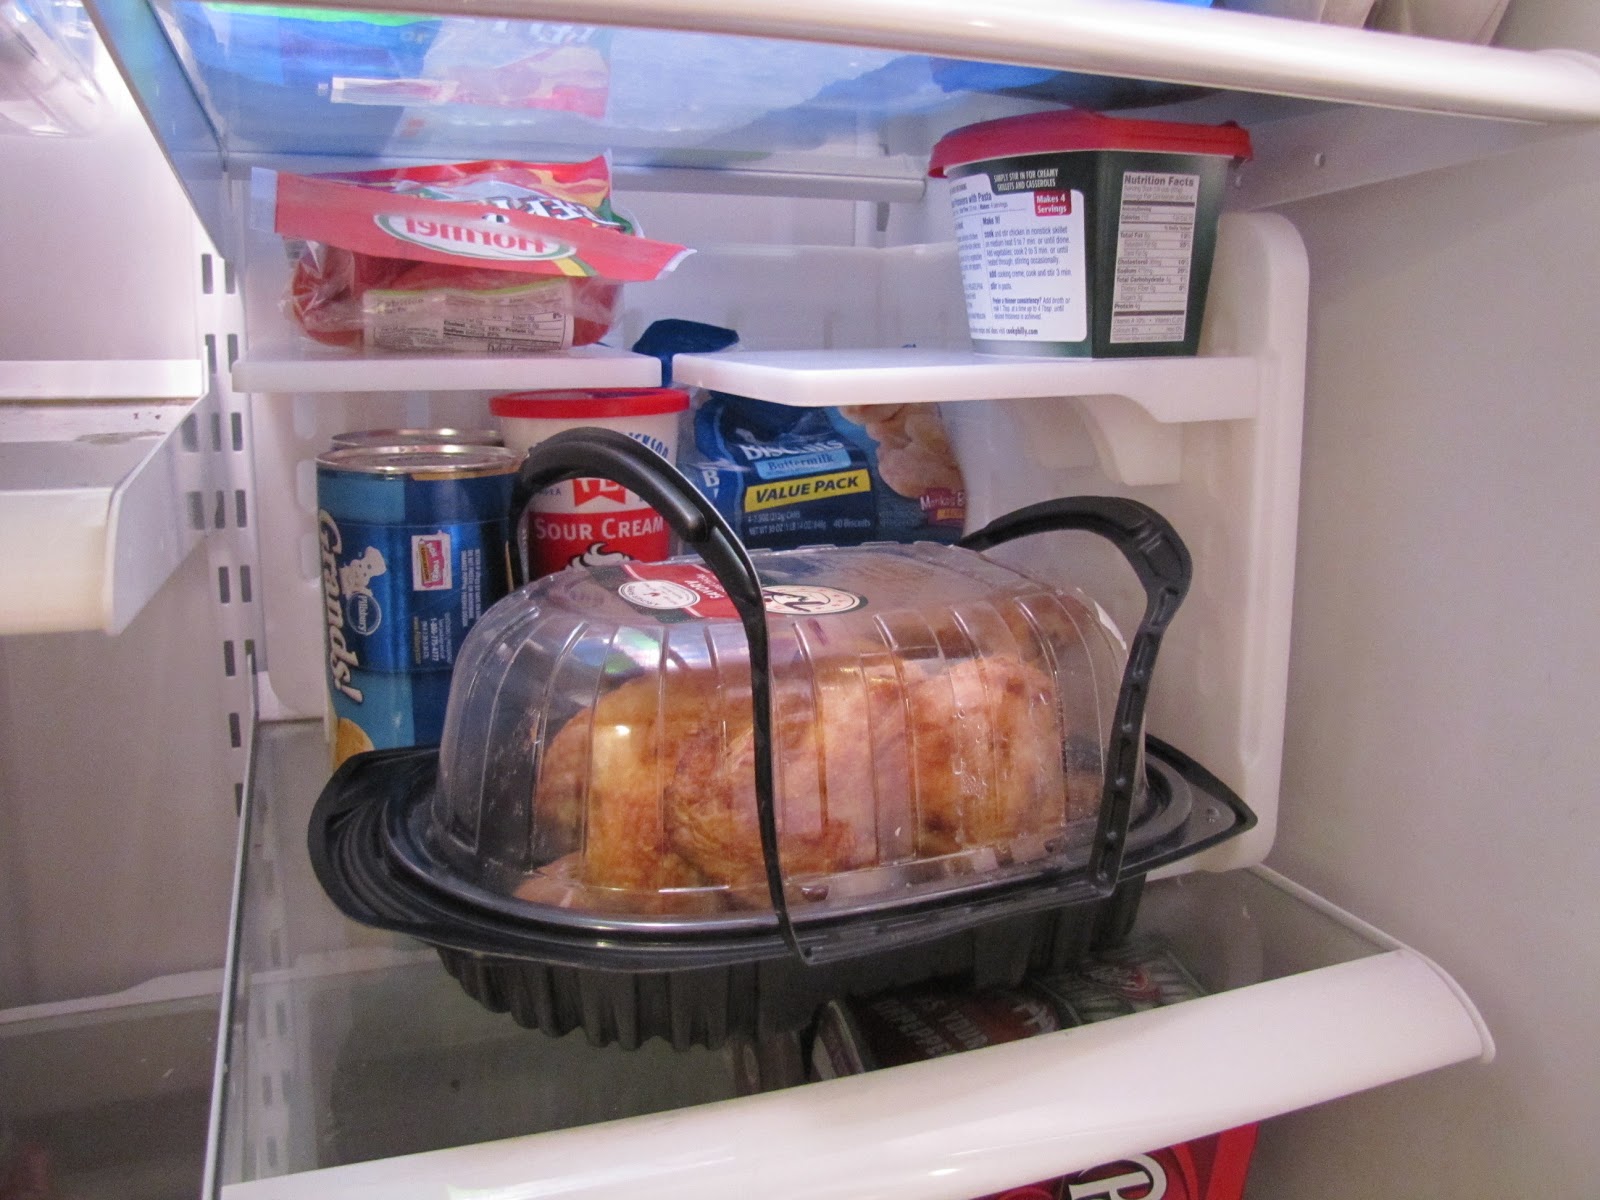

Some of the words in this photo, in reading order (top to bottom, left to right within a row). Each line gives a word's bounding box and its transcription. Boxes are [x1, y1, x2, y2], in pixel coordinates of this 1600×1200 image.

[1124, 175, 1166, 184] Nutrition
[1168, 176, 1194, 186] Facts
[1037, 195, 1058, 204] Makes
[1060, 194, 1066, 202] 4
[1037, 204, 1067, 214] Servings
[1031, 228, 1051, 236] nonstick
[1052, 226, 1068, 234] skillet
[1056, 246, 1068, 254] until
[768, 454, 834, 470] Buttermilk
[756, 483, 811, 504] VALUE
[814, 476, 859, 494] PACK
[534, 518, 593, 540] SOUR
[602, 516, 664, 540] CREAM
[319, 508, 364, 705] Grands!
[358, 595, 370, 632] Pillsbury
